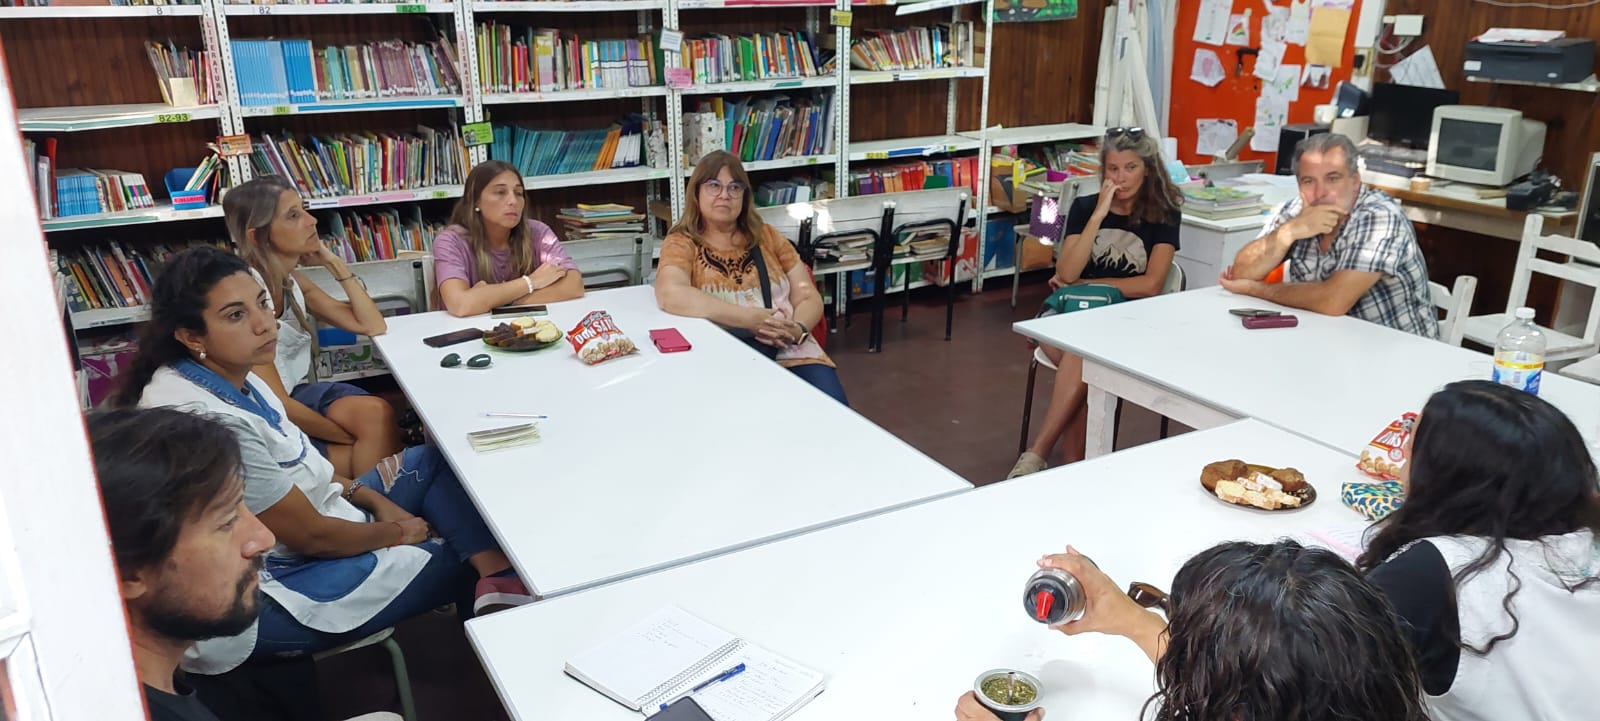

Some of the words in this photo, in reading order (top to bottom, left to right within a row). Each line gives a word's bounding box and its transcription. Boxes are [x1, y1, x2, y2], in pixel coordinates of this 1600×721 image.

[258, 6, 271, 15] 82
[206, 21, 223, 97] LITERATURA
[460, 34, 471, 102] LITERATURA
[158, 113, 188, 122] 82-93
